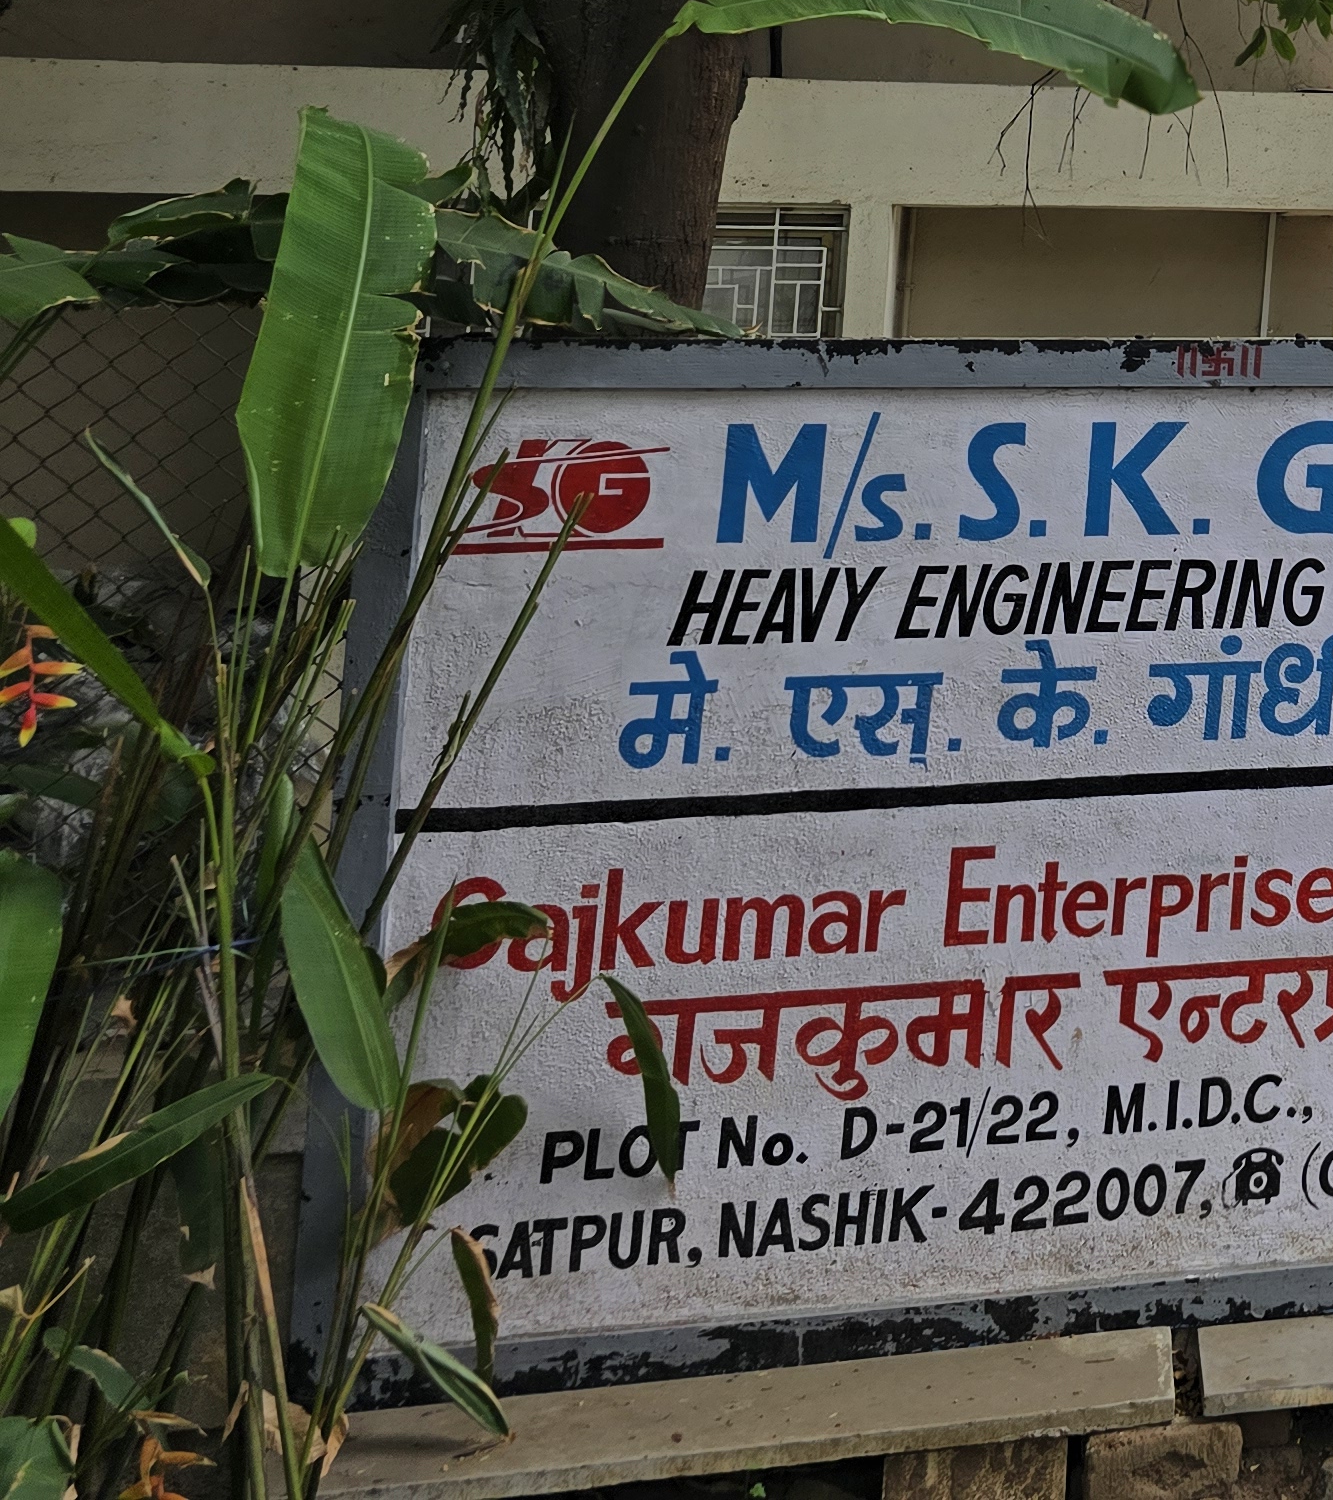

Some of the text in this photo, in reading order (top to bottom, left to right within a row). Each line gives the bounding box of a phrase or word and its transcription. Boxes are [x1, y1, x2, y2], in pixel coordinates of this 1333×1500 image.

[665, 566, 888, 647] HEAVY
[894, 557, 1326, 641] ENGINEERING
[618, 650, 730, 769] मे.
[997, 639, 1108, 748] के.
[716, 1114, 809, 1169] No.
[468, 1208, 703, 1280] SATPUR,
